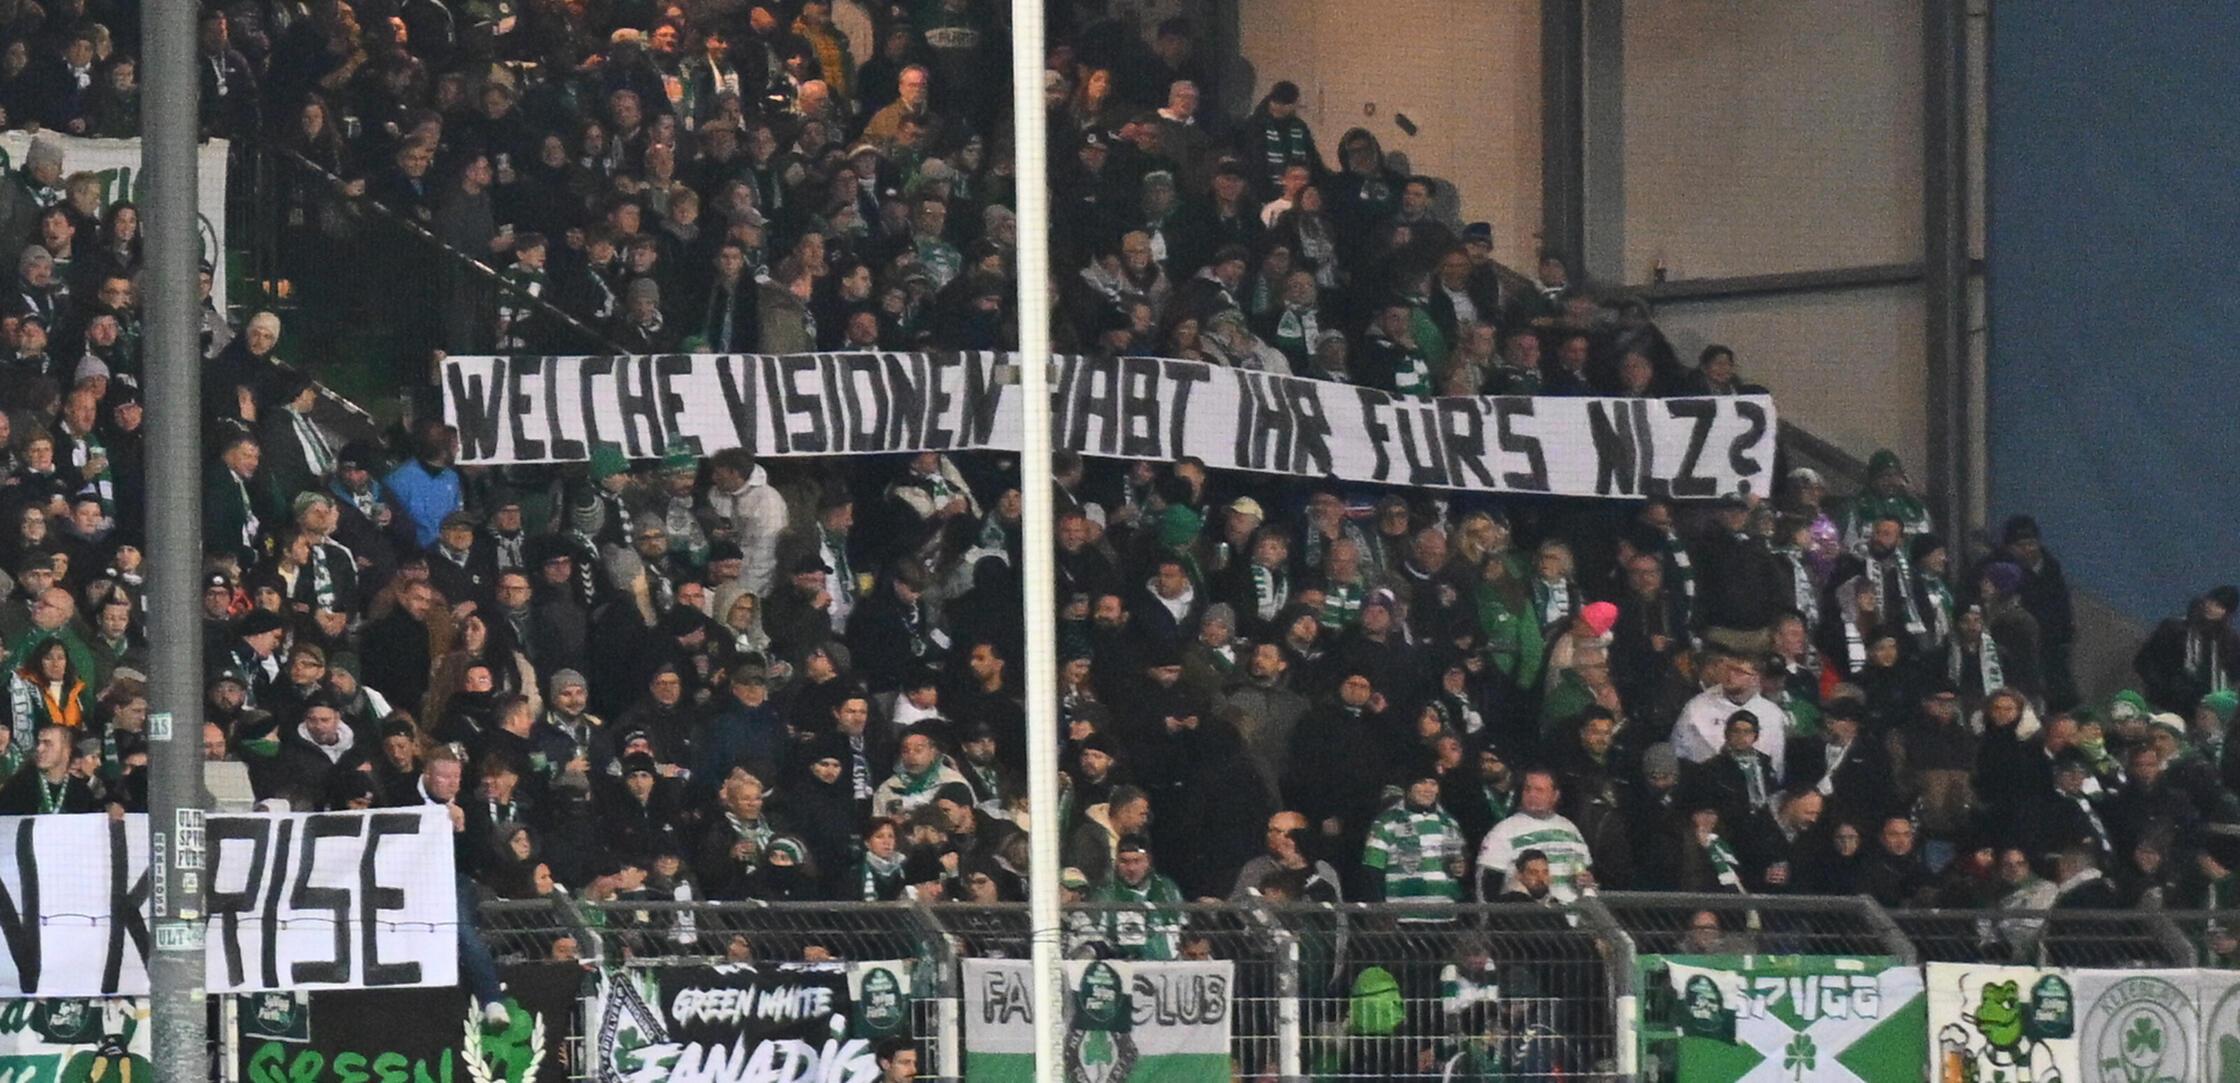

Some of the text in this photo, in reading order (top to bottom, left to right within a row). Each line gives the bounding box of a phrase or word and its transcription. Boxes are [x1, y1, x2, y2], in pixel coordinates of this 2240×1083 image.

[447, 355, 703, 460] WELCHE
[717, 350, 1008, 454] VISIONEN
[1234, 369, 1332, 477] IHR
[1356, 387, 1550, 491] FÜR'S
[1588, 398, 1767, 497] NLZ?
[672, 984, 755, 1027] GREEN
[757, 985, 834, 1022] WHITE
[1131, 974, 1227, 1025] CLUB
[248, 1041, 454, 1083] GREEN
